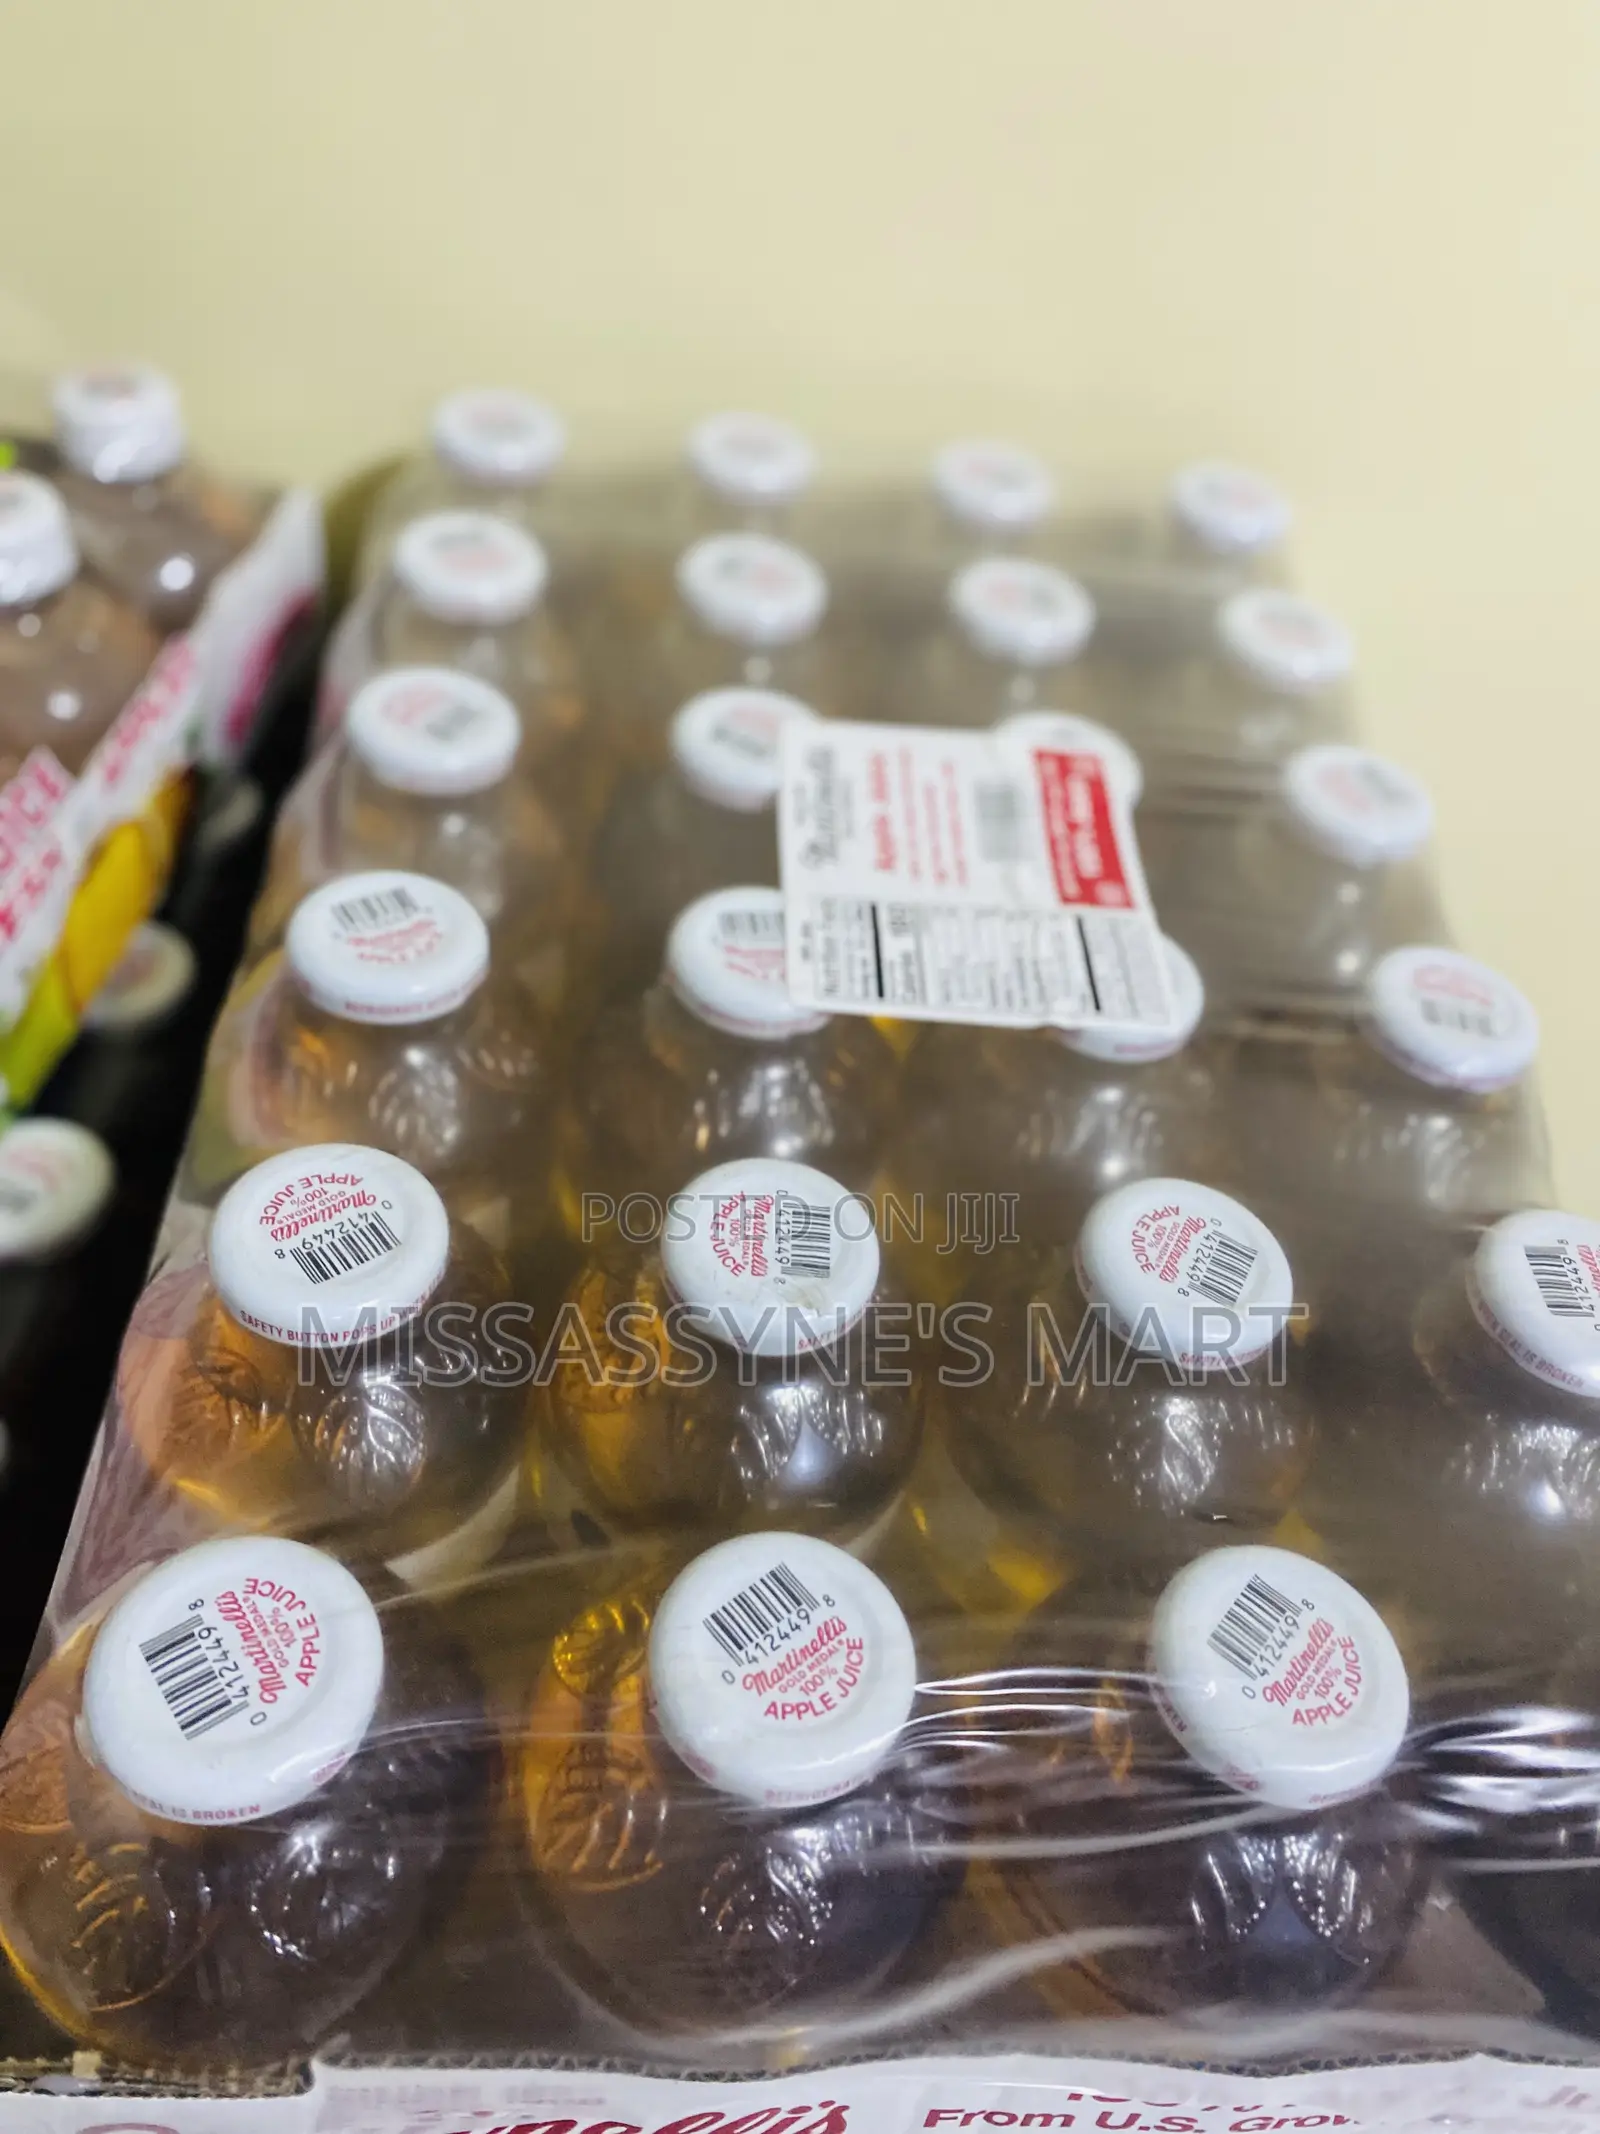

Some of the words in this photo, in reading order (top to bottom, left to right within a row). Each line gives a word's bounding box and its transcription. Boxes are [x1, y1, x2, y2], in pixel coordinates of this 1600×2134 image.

[298, 1173, 364, 1190] APPLE
[260, 1184, 294, 1225] JUICE
[290, 1188, 328, 1208] 100%
[318, 1190, 346, 1206] GOLD
[381, 1200, 392, 1210] 0
[302, 1212, 368, 1250] 412449
[1136, 1206, 1180, 1232] APPLE
[775, 1209, 790, 1264] 412449
[1132, 1230, 1156, 1274] JUICE
[274, 1248, 286, 1259] 8
[710, 1234, 746, 1277] JUICE
[1186, 1234, 1217, 1282] 412449
[1178, 1288, 1190, 1297] 8
[1563, 1257, 1595, 1311] 412449
[240, 1310, 284, 1337] SAFETY
[288, 1330, 338, 1344] BUTTON
[342, 1322, 376, 1341] POPS
[380, 1316, 396, 1330] UP
[188, 1599, 204, 1610] 8
[242, 1578, 306, 1611] JUICE
[267, 1607, 297, 1648] 100%
[722, 1670, 736, 1685] 0
[744, 1608, 810, 1664] 412449
[822, 1594, 836, 1607] 8
[198, 1626, 250, 1699] 412449
[267, 1637, 289, 1668] GOLD
[295, 1613, 320, 1686] APPLE
[1242, 1686, 1256, 1699] 0
[1254, 1615, 1300, 1676] 412449
[1302, 1598, 1314, 1610] 8
[764, 1692, 837, 1720] APPLE
[836, 1638, 864, 1698] JUICE
[778, 1670, 806, 1693] GOLD
[800, 1666, 838, 1696] 100%
[1292, 1692, 1353, 1726] APPLE
[1337, 1636, 1362, 1696] JUICE
[1296, 1674, 1316, 1700] GOLD
[1314, 1667, 1342, 1699] 100%
[251, 1711, 267, 1726] 0
[192, 1804, 261, 1820] BROKEN
[923, 2107, 1075, 2128] From
[1095, 2111, 1207, 2133] U.S.
